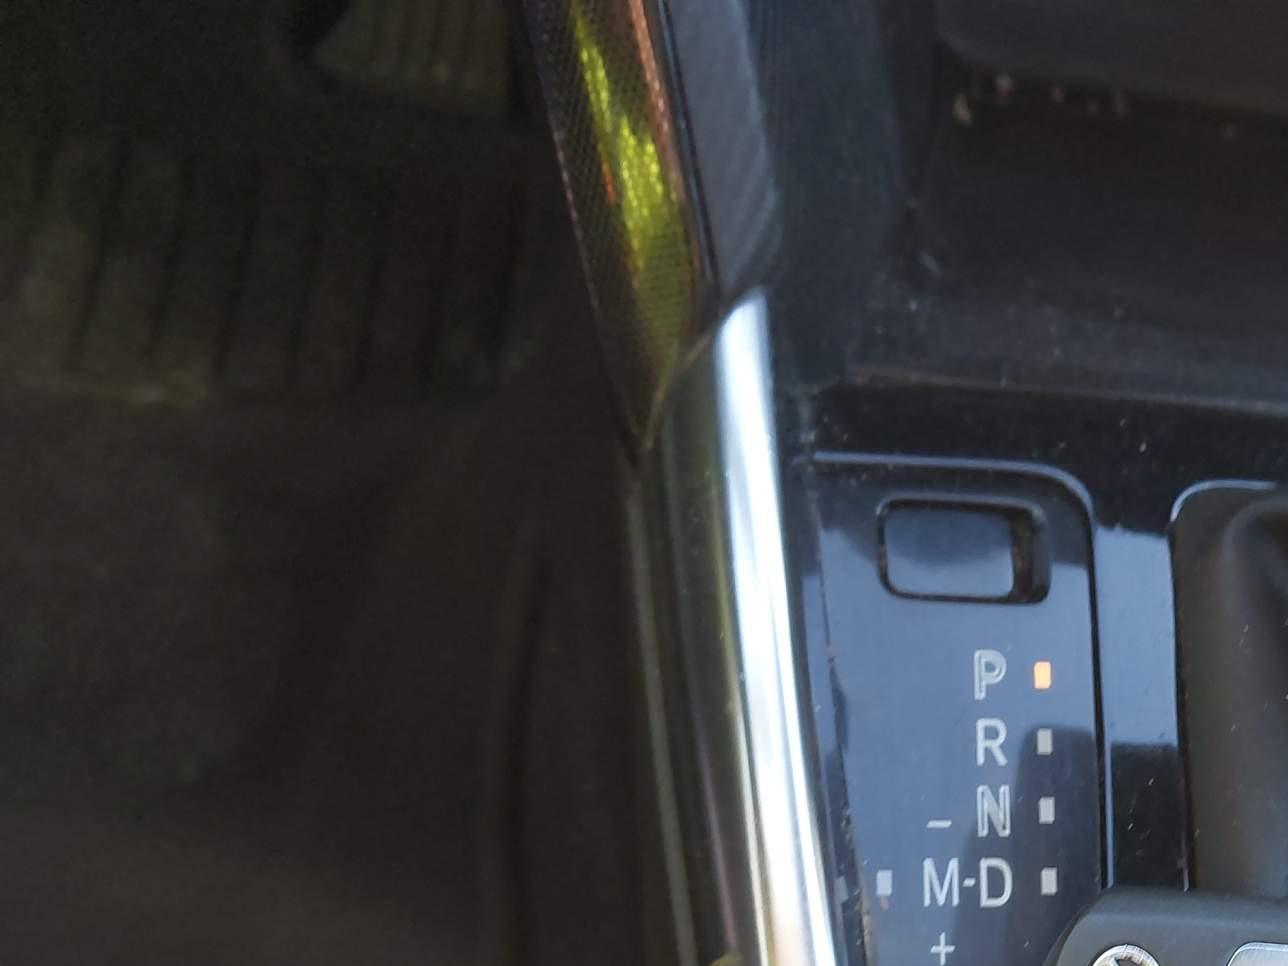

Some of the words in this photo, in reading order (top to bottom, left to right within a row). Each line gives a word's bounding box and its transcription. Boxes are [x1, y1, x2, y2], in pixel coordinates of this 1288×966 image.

[973, 649, 1007, 700] P
[976, 718, 1008, 766] R
[976, 785, 1011, 838] N
